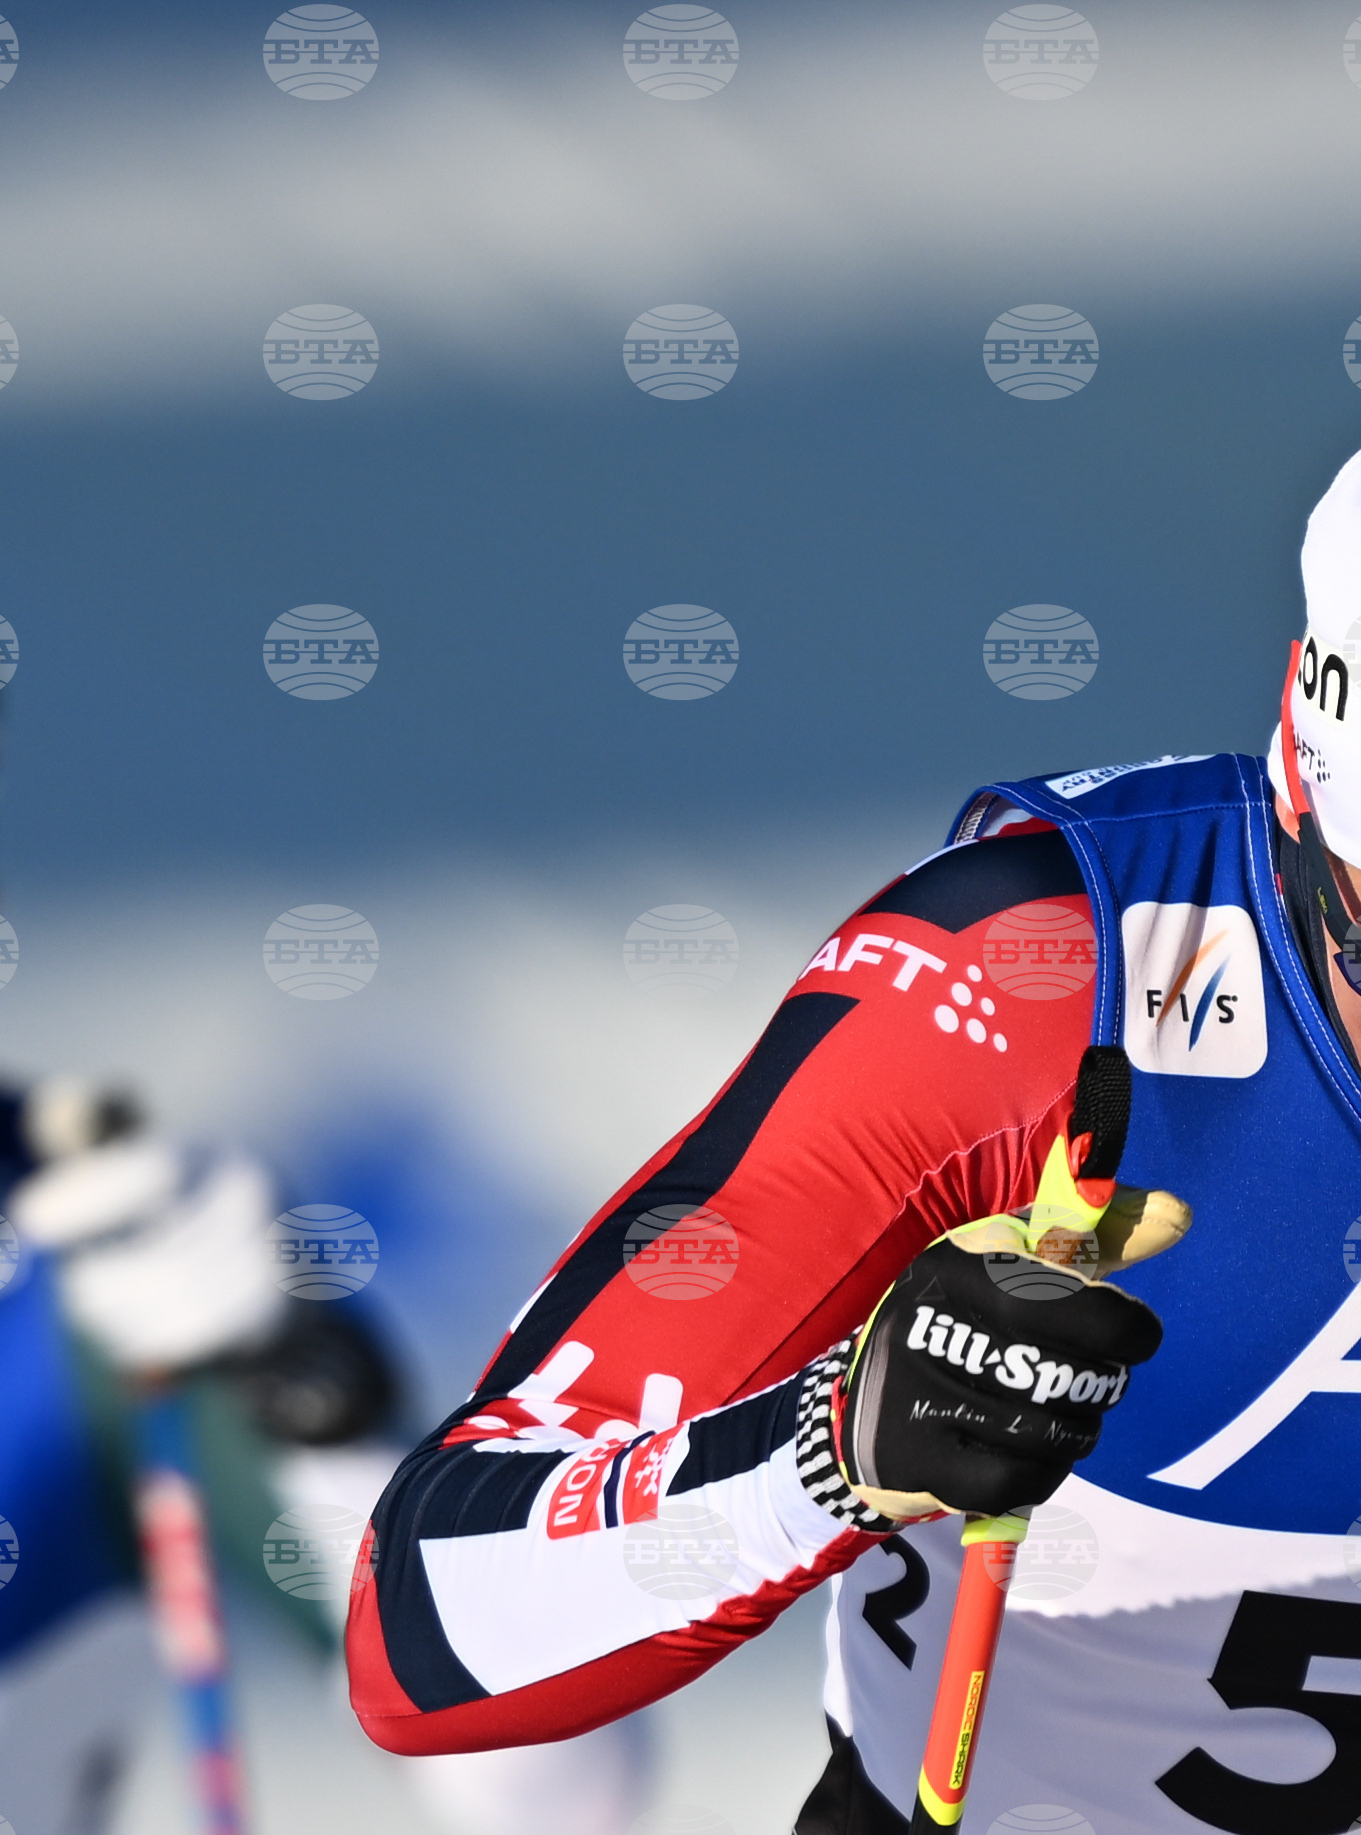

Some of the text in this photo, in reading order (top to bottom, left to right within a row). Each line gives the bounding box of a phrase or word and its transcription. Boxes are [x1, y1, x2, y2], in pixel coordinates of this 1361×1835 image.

[1297, 635, 1349, 722] on
[796, 932, 948, 993] AFT
[1145, 988, 1237, 1026] FIS
[951, 1731, 971, 1787] SHARK
